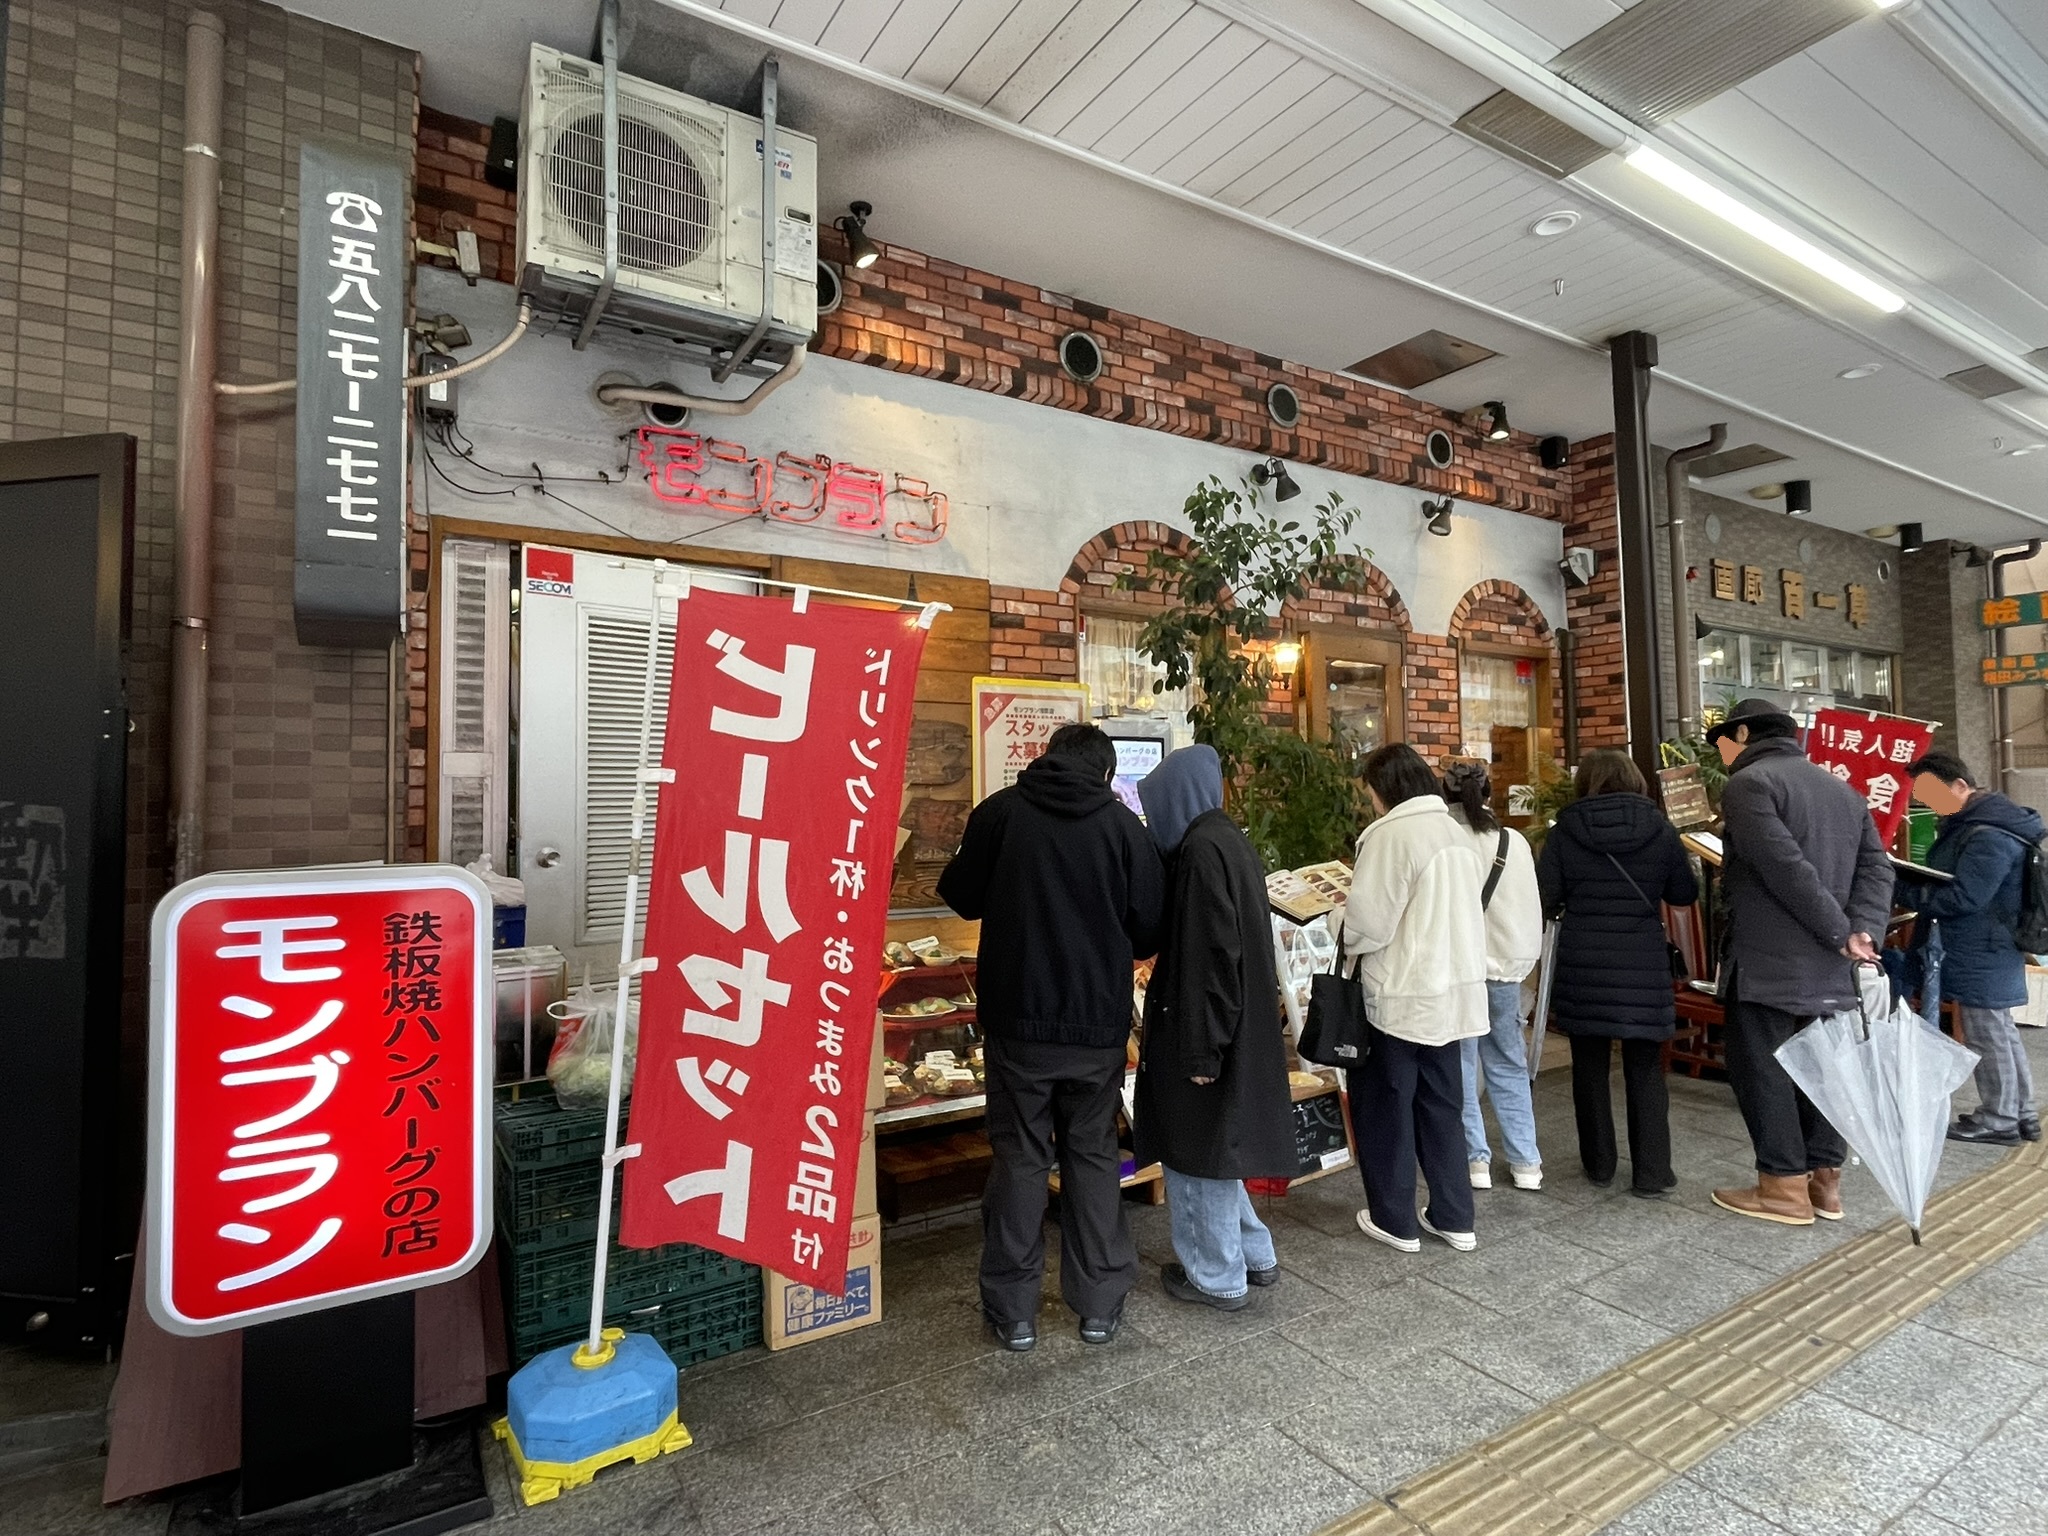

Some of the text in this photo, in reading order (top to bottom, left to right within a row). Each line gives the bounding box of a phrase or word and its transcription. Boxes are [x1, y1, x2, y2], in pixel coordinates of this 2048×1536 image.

[528, 580, 571, 595] SECOM
[638, 425, 948, 545] モンブラン
[215, 915, 350, 1292] モンブラン
[381, 911, 442, 1258] 鉄板焼ハンバーグの店
